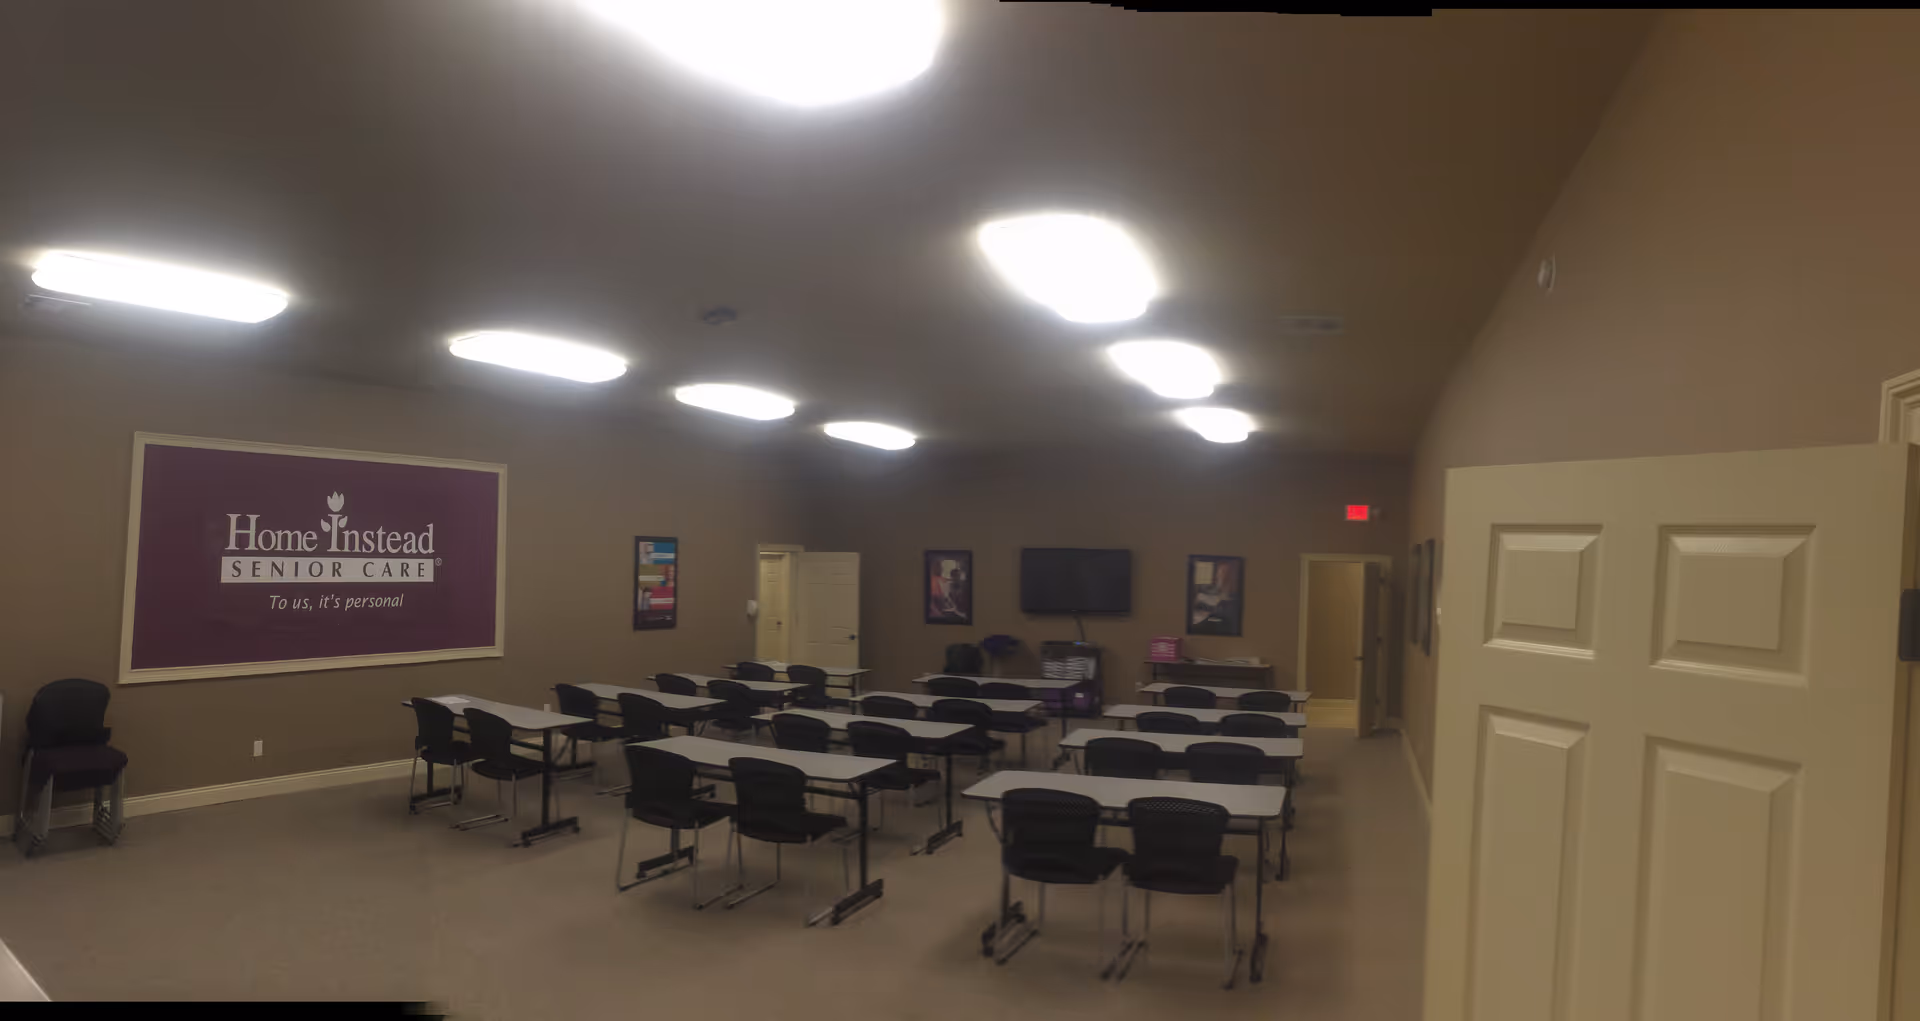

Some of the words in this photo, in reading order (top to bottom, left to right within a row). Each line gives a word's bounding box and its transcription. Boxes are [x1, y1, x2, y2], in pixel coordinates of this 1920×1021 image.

[224, 513, 318, 552] Home
[326, 514, 435, 554] Instead
[231, 560, 342, 578] SENIOR
[362, 561, 425, 578] CARE
[269, 595, 288, 610] To
[292, 598, 313, 611] us,
[318, 593, 341, 609] it's
[345, 593, 404, 611] personal
